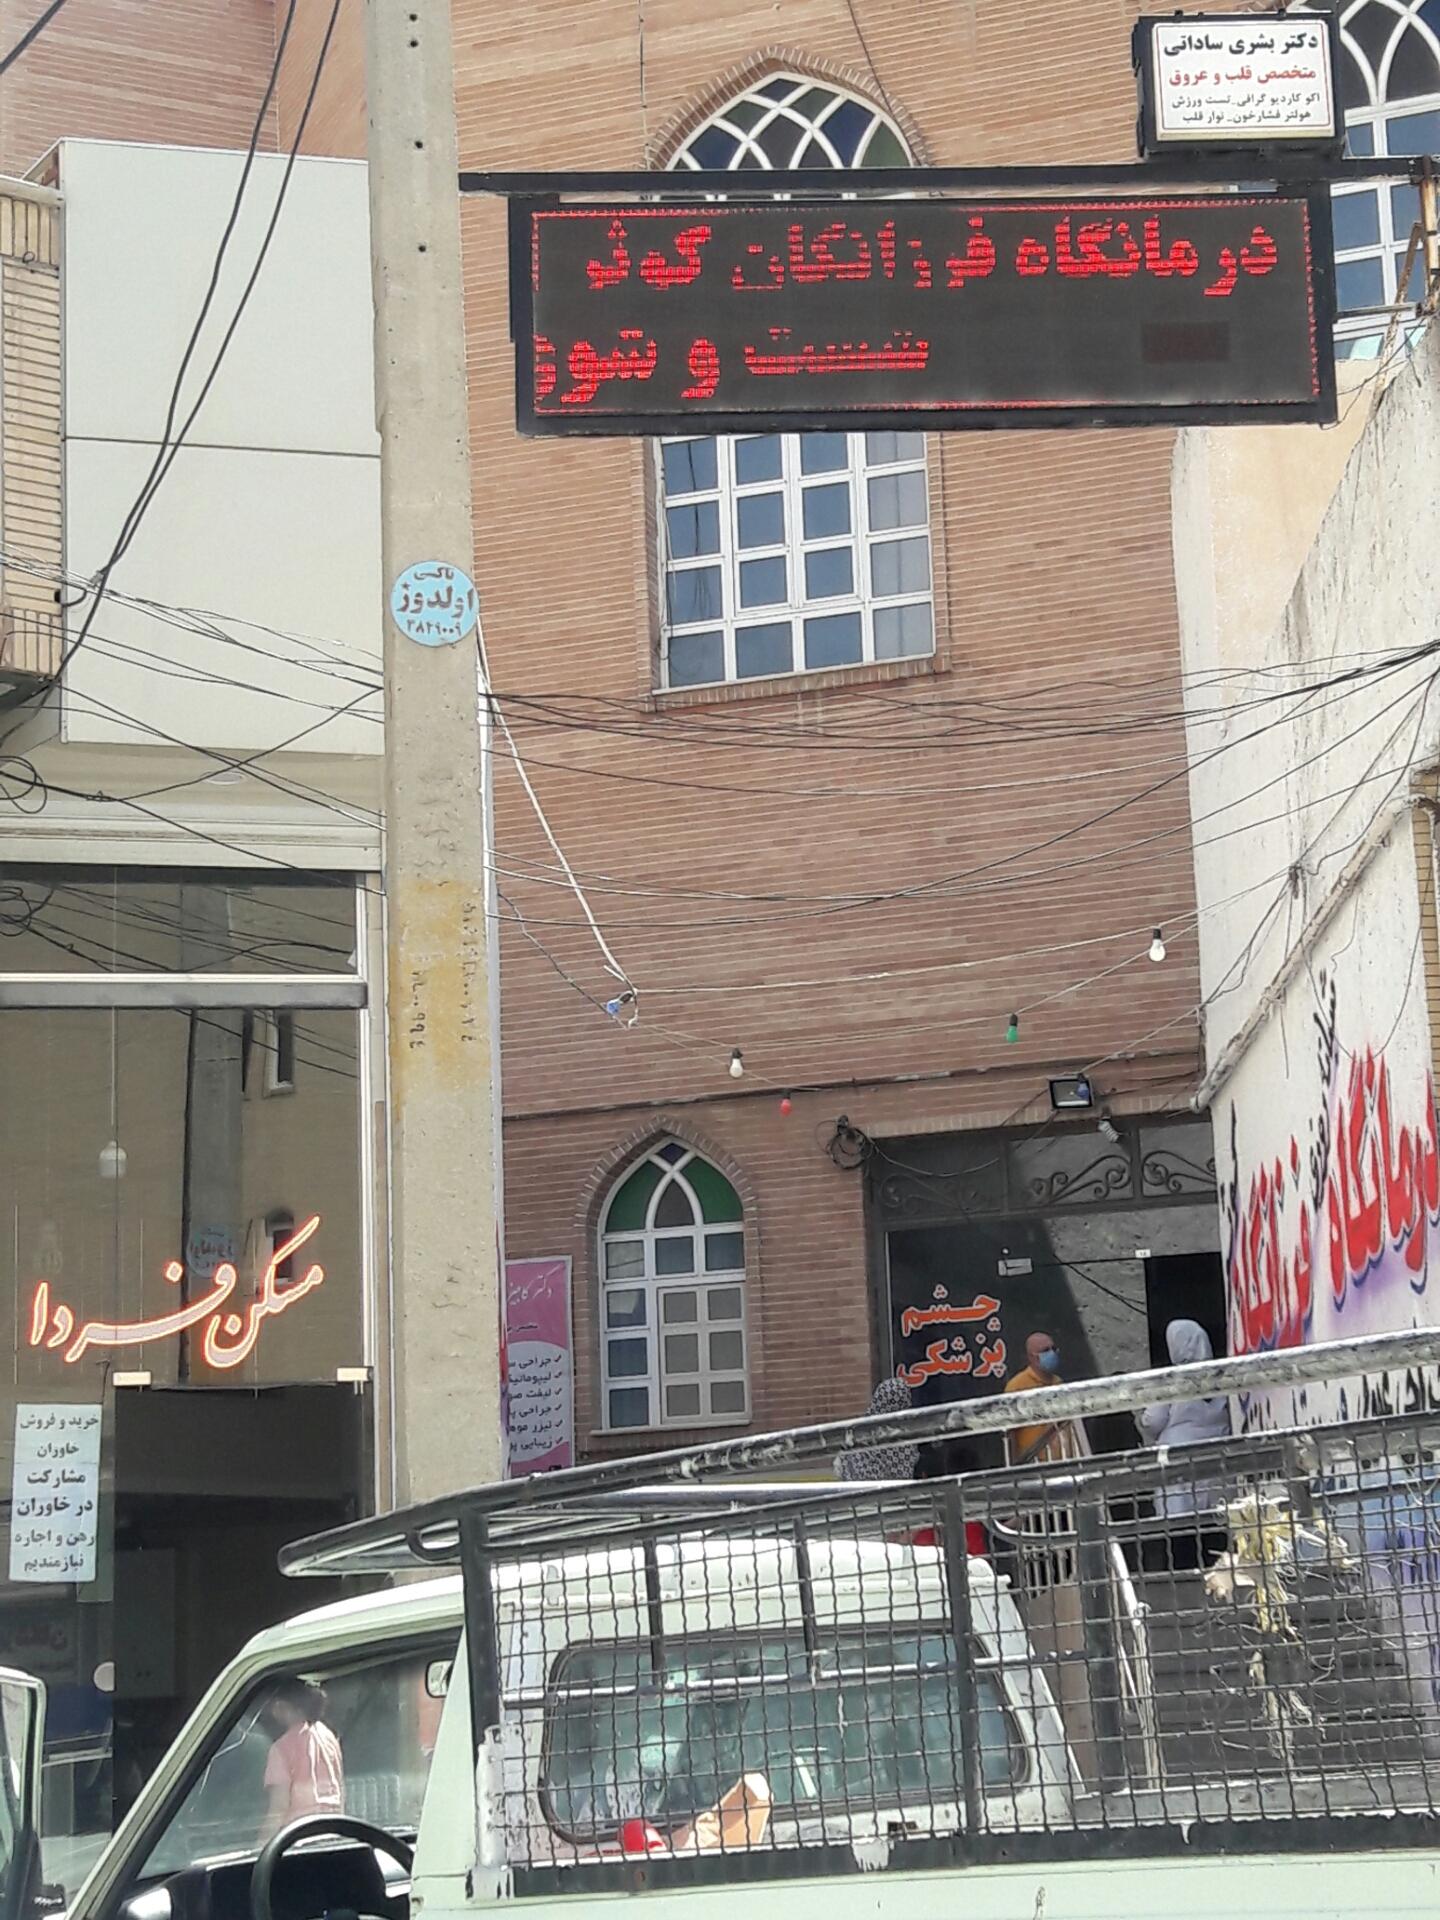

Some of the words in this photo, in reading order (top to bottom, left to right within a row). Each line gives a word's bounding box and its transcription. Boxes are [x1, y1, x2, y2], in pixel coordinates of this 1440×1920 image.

[1164, 34, 1223, 56] ساداتی
[1228, 33, 1275, 55] بشری
[1281, 33, 1319, 54] دکتر
[1169, 70, 1208, 86] عروق
[1213, 71, 1221, 85] و
[1225, 64, 1252, 84] قلب
[1257, 65, 1317, 84] متخصص
[1172, 95, 1202, 108] ورزش
[1305, 92, 1320, 105] اکو
[1182, 110, 1203, 123] قلب
[733, 216, 996, 290] فرزانگان
[1015, 213, 1278, 296] درمانگاه
[396, 582, 475, 618] اولدوز
[203, 1215, 324, 1368] مسکن
[29, 1260, 237, 1363] فردا
[901, 1284, 1000, 1336] چشم
[897, 1332, 1006, 1387] پزشکی
[20, 1412, 55, 1430] فروش
[59, 1419, 66, 1429] و
[69, 1414, 99, 1430] خرید
[37, 1442, 79, 1458] خاوران
[27, 1468, 86, 1488] مشارکت
[17, 1496, 70, 1516] خاوران
[75, 1499, 93, 1516] در
[15, 1529, 52, 1547] اجاره
[55, 1535, 63, 1546] و
[66, 1532, 95, 1547] رهن
[24, 1553, 84, 1572] نیازمندیم
